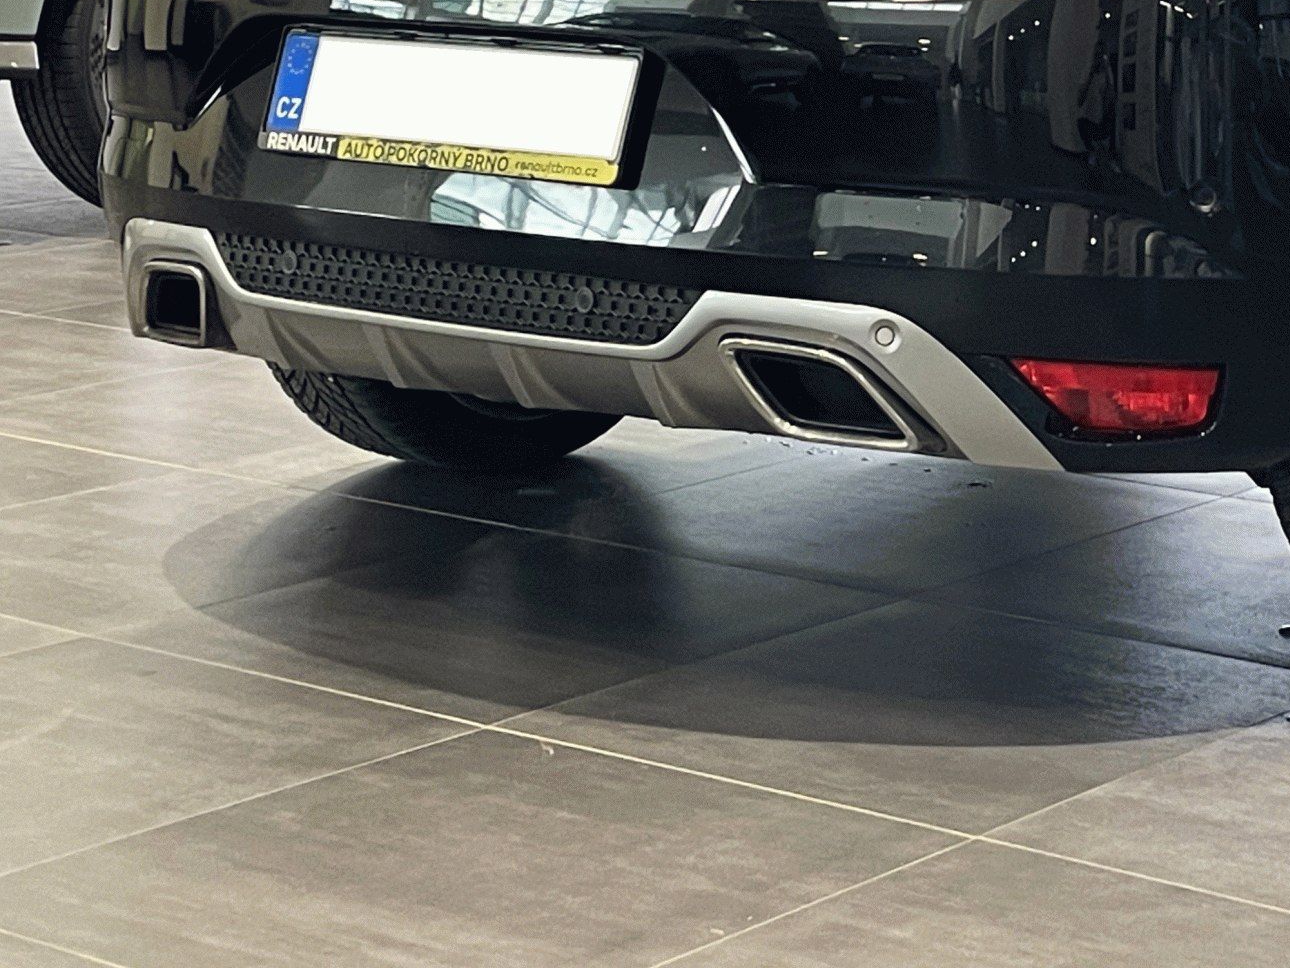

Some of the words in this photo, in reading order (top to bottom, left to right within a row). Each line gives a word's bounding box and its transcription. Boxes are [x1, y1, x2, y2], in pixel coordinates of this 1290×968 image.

[276, 96, 302, 119] CZ
[266, 131, 338, 155] RENAULT
[463, 152, 509, 172] BRNO
